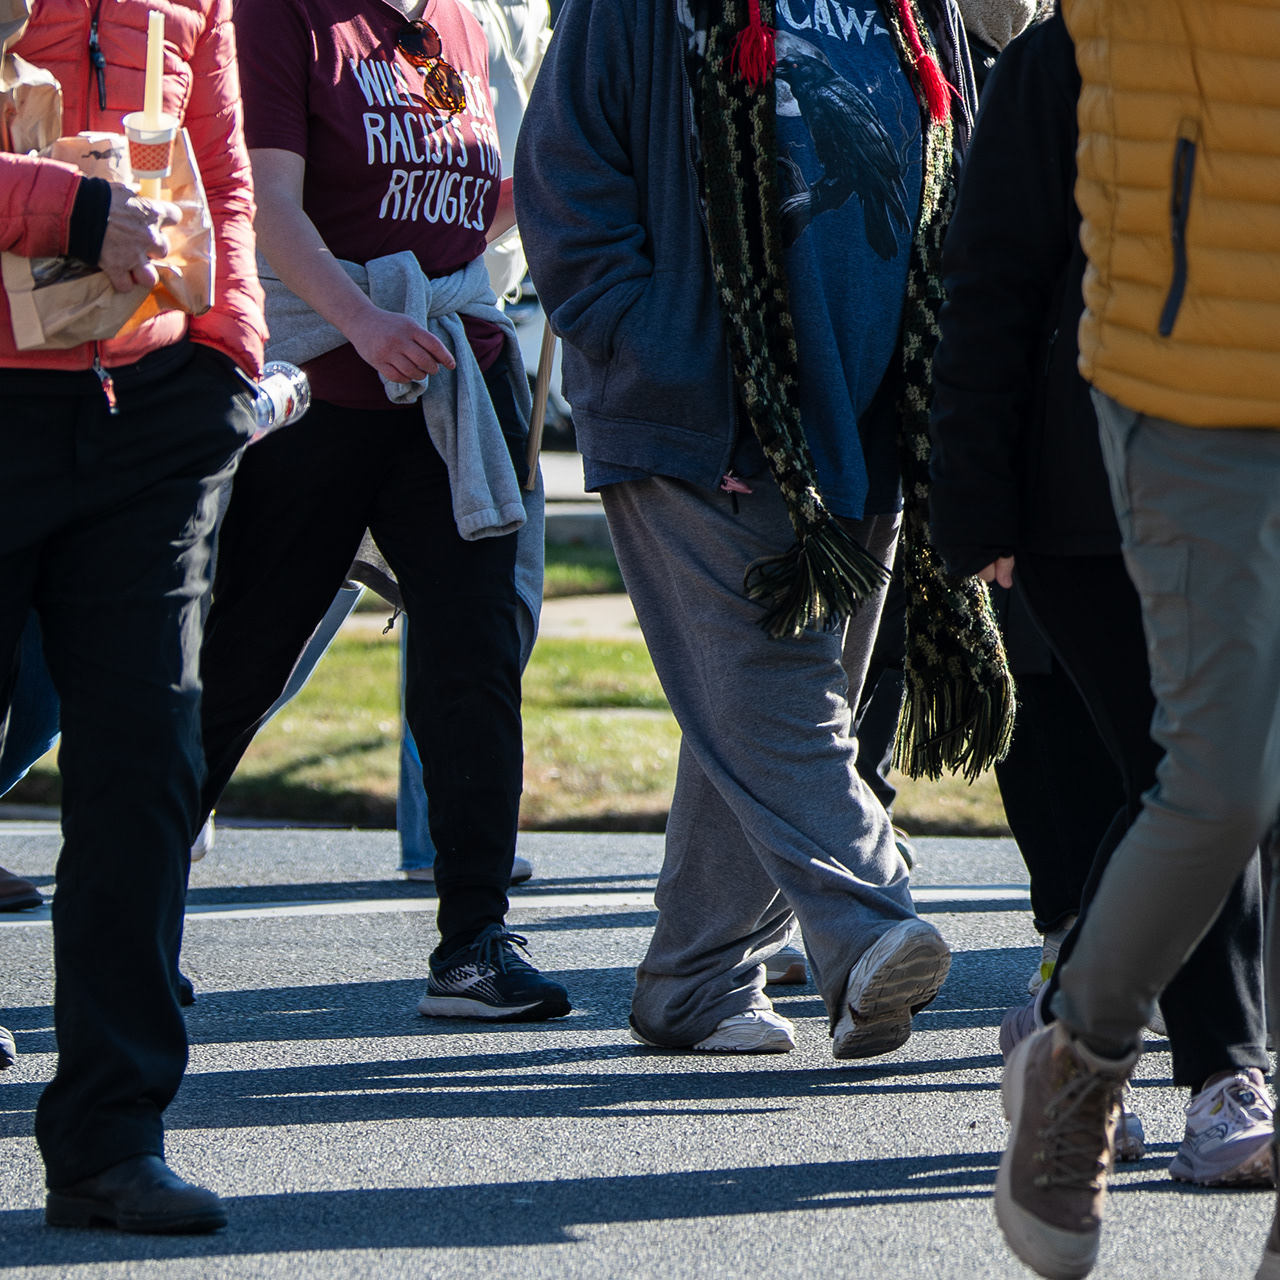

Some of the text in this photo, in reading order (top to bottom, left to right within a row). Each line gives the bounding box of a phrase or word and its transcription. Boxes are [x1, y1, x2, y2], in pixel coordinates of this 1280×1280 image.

[349, 58, 423, 108] WILL
[362, 112, 468, 168] RACISTS
[378, 169, 491, 231] REFUGEES
